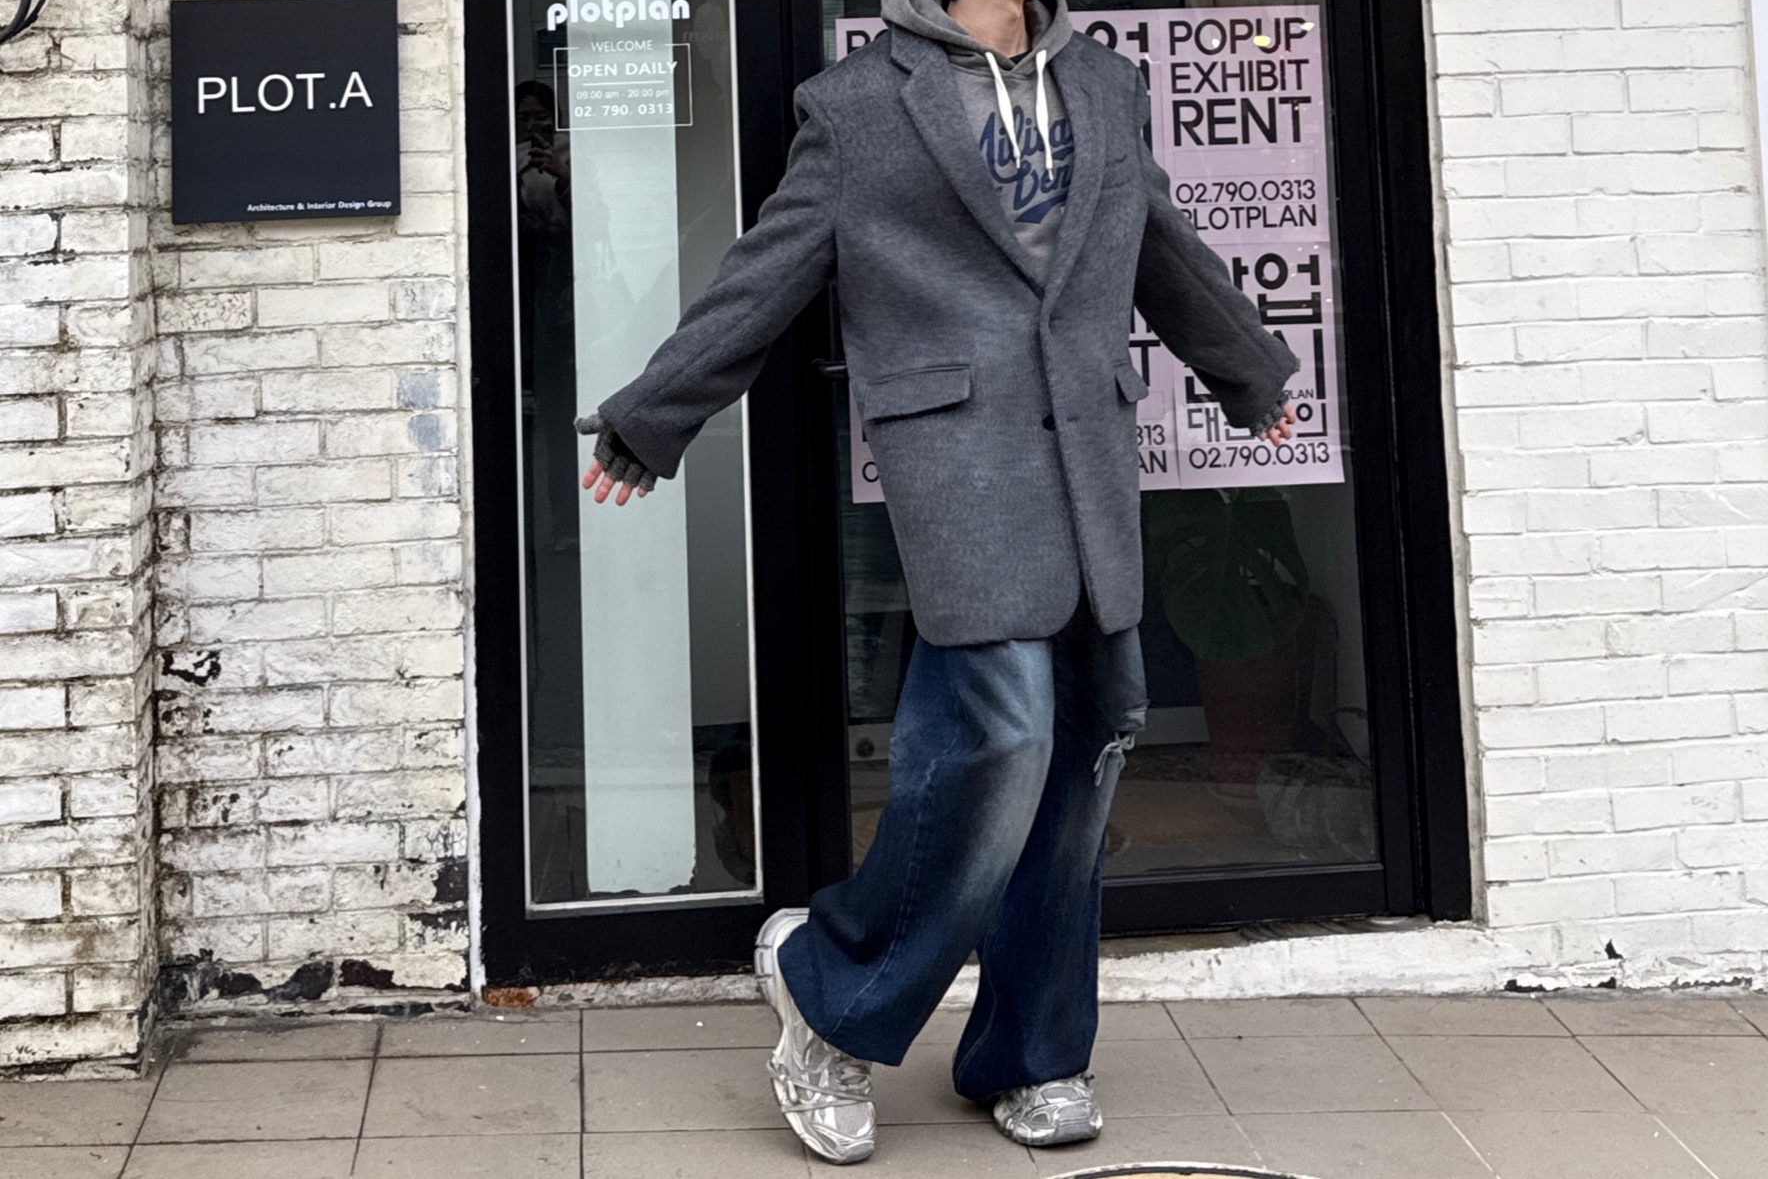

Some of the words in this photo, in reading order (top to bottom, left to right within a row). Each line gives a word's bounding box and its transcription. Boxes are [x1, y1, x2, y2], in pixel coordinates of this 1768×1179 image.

[591, 39, 653, 52] WELCOME
[1168, 17, 1309, 56] POPUP
[568, 63, 618, 78] OPEN
[625, 61, 678, 76] DAILY
[1170, 59, 1309, 94] EXHIBIT
[197, 71, 374, 115] PLOT.A
[637, 102, 675, 115] 0313
[1172, 95, 1312, 147] RENT
[1175, 178, 1316, 205] 02.790.0313
[247, 203, 295, 212] Architecture
[297, 202, 305, 211] &
[307, 201, 336, 210] Interior
[338, 200, 365, 211] Design
[367, 199, 392, 209] Group
[1189, 442, 1330, 470] 02.790.0313
